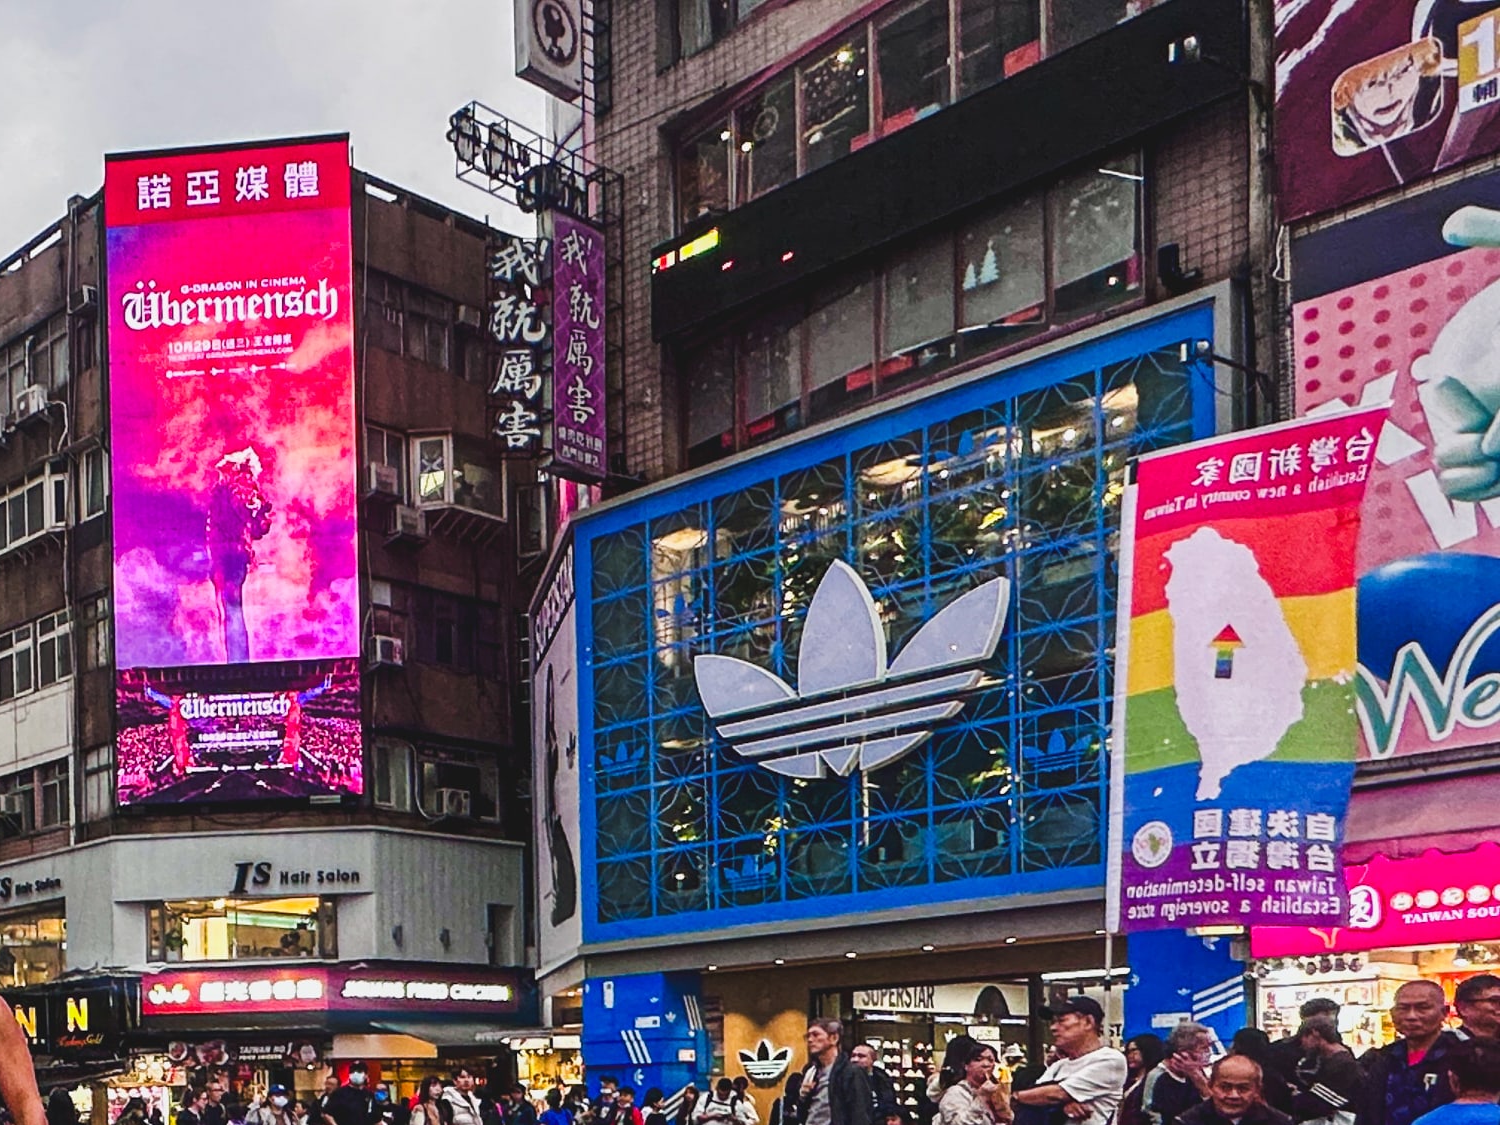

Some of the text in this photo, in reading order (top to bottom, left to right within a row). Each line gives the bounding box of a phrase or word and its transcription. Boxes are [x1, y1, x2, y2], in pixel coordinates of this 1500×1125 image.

[137, 161, 319, 210] 諾亞媒體
[180, 276, 306, 295] G-DRAGON IN CINEMA
[121, 278, 339, 330] Übermensch
[179, 692, 292, 720] Übermensch
[280, 870, 311, 885] Hair
[317, 868, 360, 884] Salon
[1402, 909, 1464, 925] TAIWAN
[861, 985, 936, 1009] SUPERSTAR
